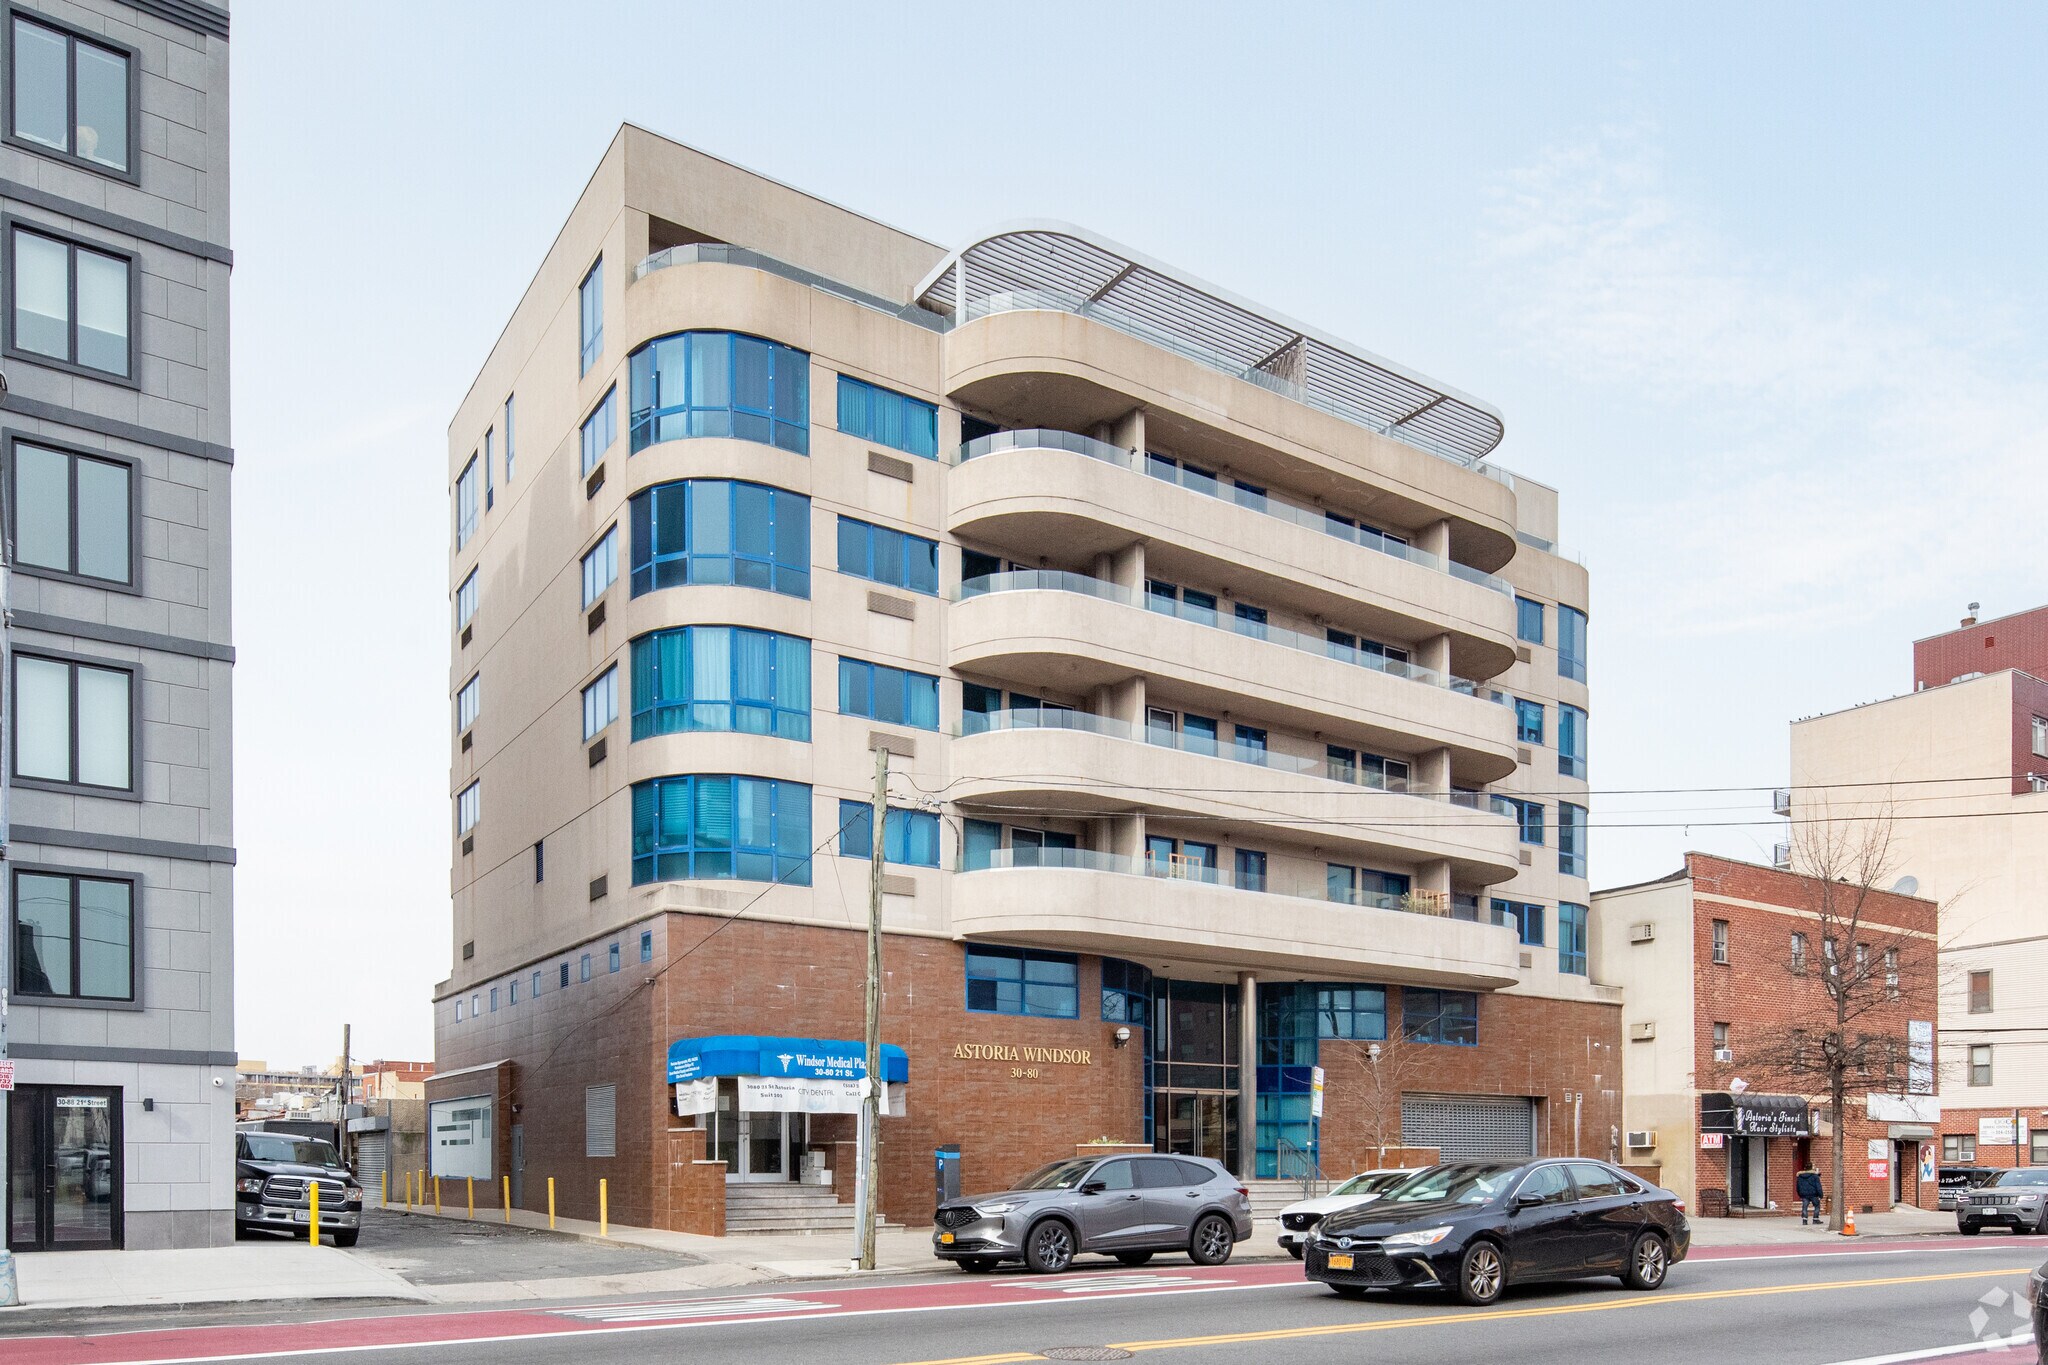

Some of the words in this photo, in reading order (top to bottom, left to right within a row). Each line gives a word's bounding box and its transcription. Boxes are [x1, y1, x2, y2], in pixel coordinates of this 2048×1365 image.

[953, 1043, 1020, 1061] ASTORIA
[1023, 1046, 1091, 1065] WINDSOR
[796, 1054, 825, 1068] Windsor
[826, 1056, 853, 1069] Medical
[814, 1068, 834, 1076] 30-80
[835, 1069, 843, 1077] 21
[1010, 1067, 1038, 1079] 30-80
[798, 1088, 809, 1096] CITY
[810, 1089, 835, 1097] DENTAL
[57, 1098, 75, 1106] 30-88
[1745, 1110, 1777, 1122] Astoria's
[1778, 1110, 1800, 1123] Finest
[1749, 1122, 1768, 1133] Hair
[1769, 1122, 1797, 1135] Stylists
[1701, 1134, 1721, 1145] ATM
